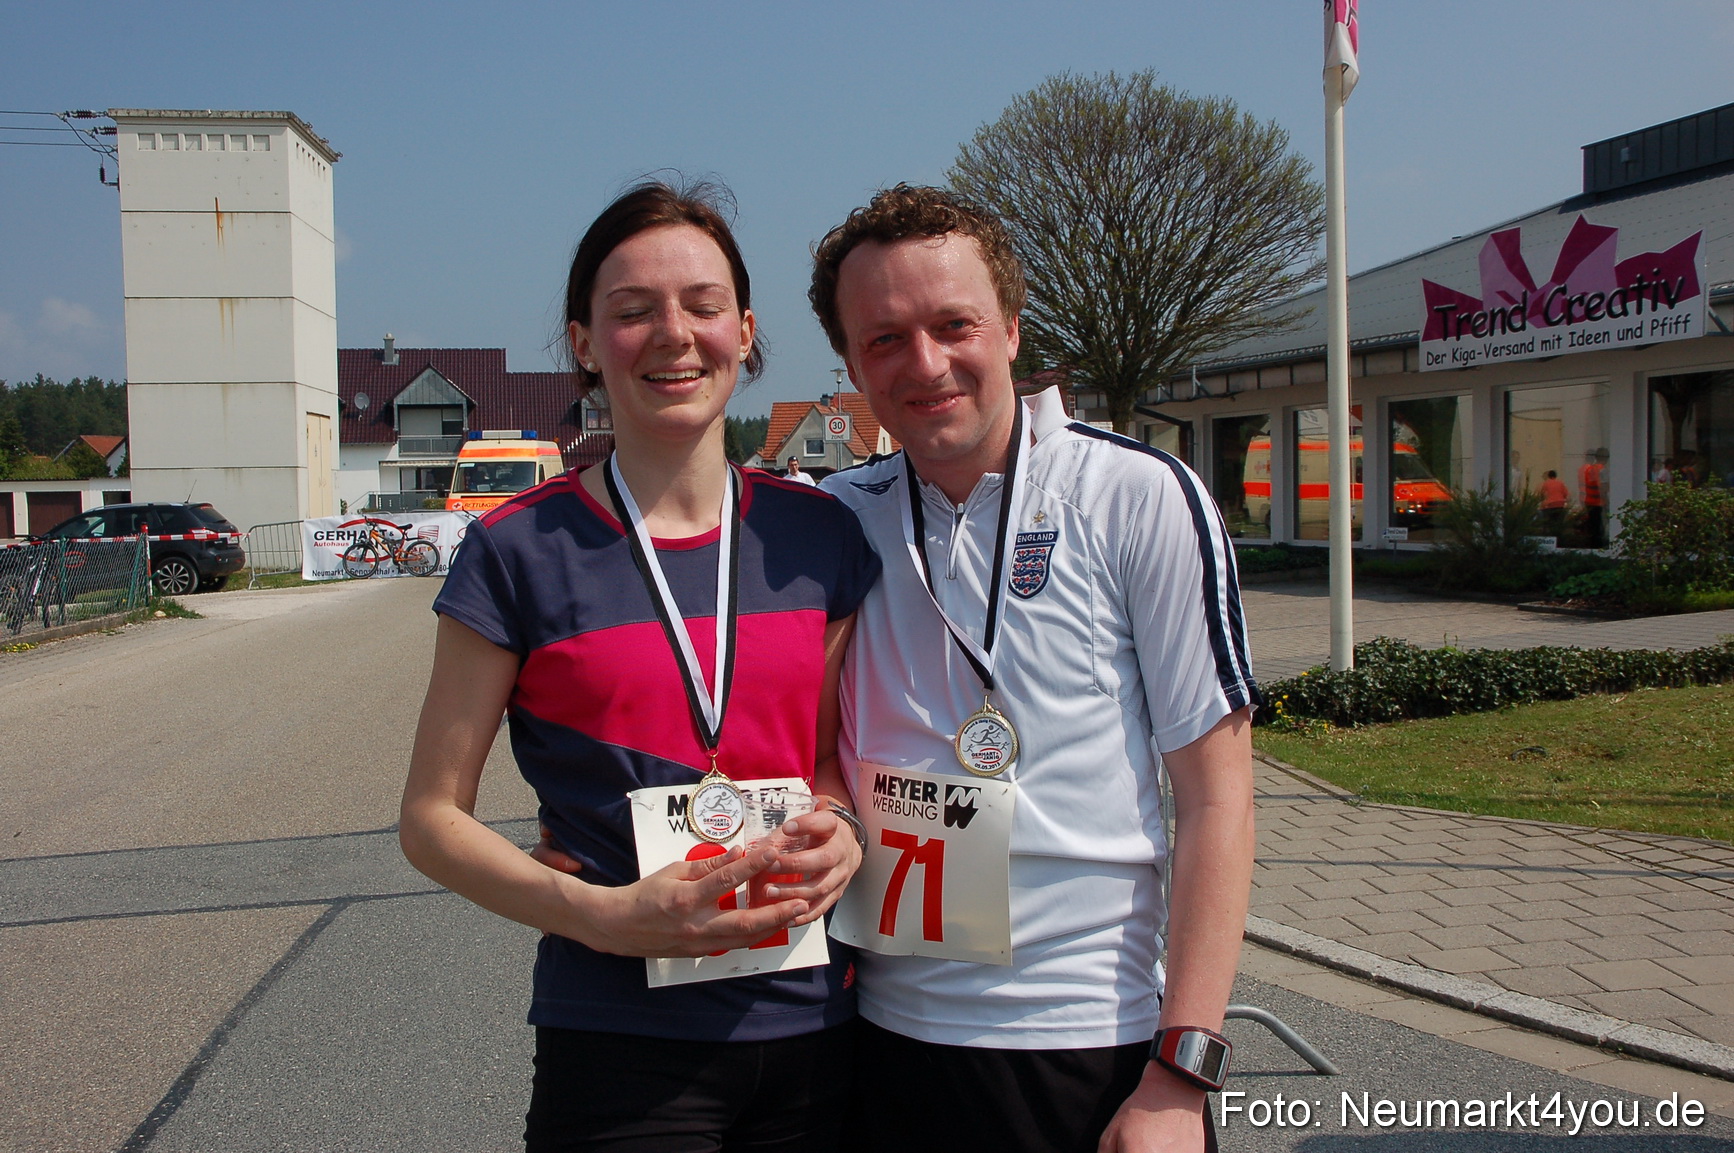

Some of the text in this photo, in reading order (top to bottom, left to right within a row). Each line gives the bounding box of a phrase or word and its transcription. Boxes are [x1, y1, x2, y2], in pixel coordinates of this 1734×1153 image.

[1433, 267, 1685, 342] Trend Creativ
[1426, 313, 1692, 367] Der Kiga-Versand mit Ideen und Pfiff
[832, 421, 843, 430] 30
[313, 529, 388, 541] GERHAT
[1017, 533, 1055, 543] ENGLAND
[312, 567, 344, 577] Neumarkt
[873, 772, 939, 804] MEYER
[872, 794, 939, 821] WERBUNG
[878, 828, 945, 943] 71
